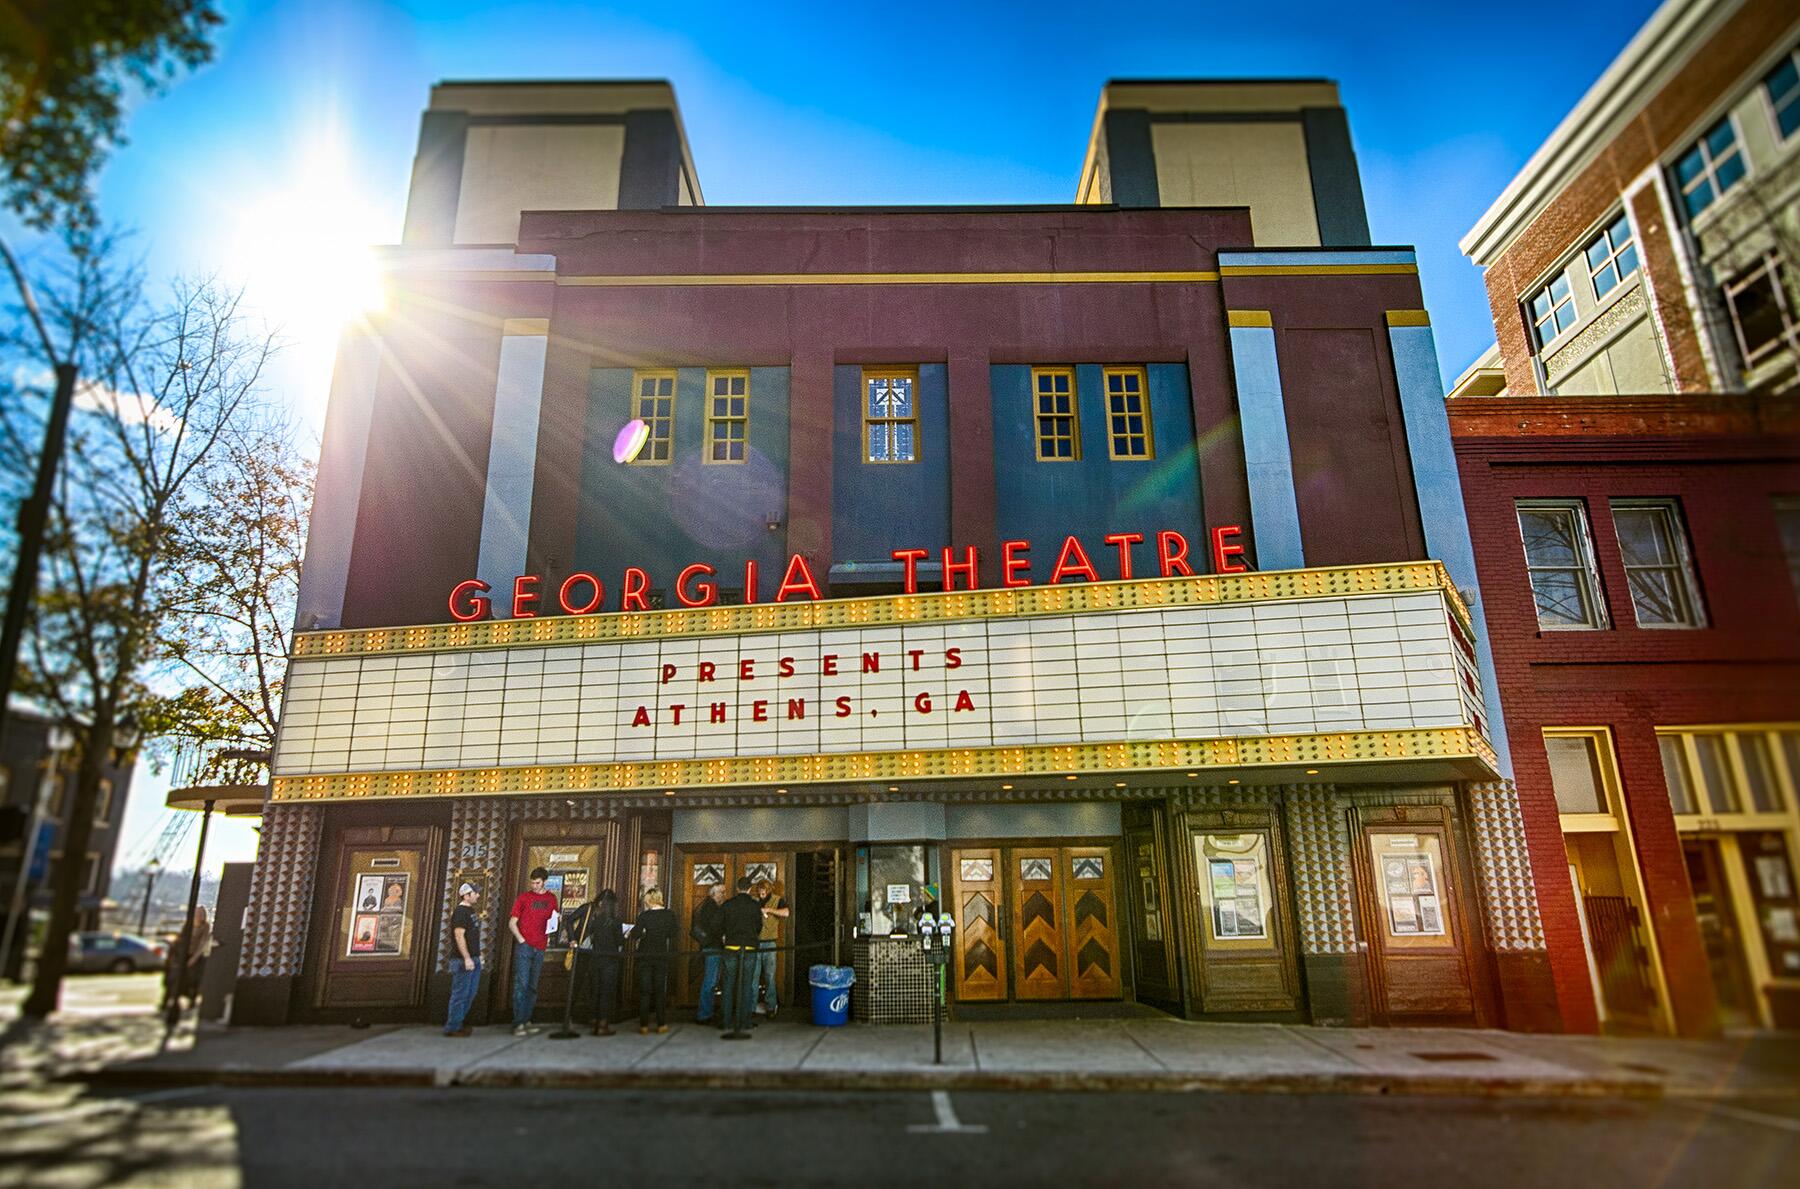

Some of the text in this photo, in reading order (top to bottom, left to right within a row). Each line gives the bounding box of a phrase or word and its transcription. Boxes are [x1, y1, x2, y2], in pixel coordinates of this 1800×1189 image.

[448, 524, 1247, 622] GEORGIA THEATRE
[660, 647, 962, 684] PRESENTS
[632, 690, 975, 727] ATHENS, GA
[462, 844, 488, 857] 215
